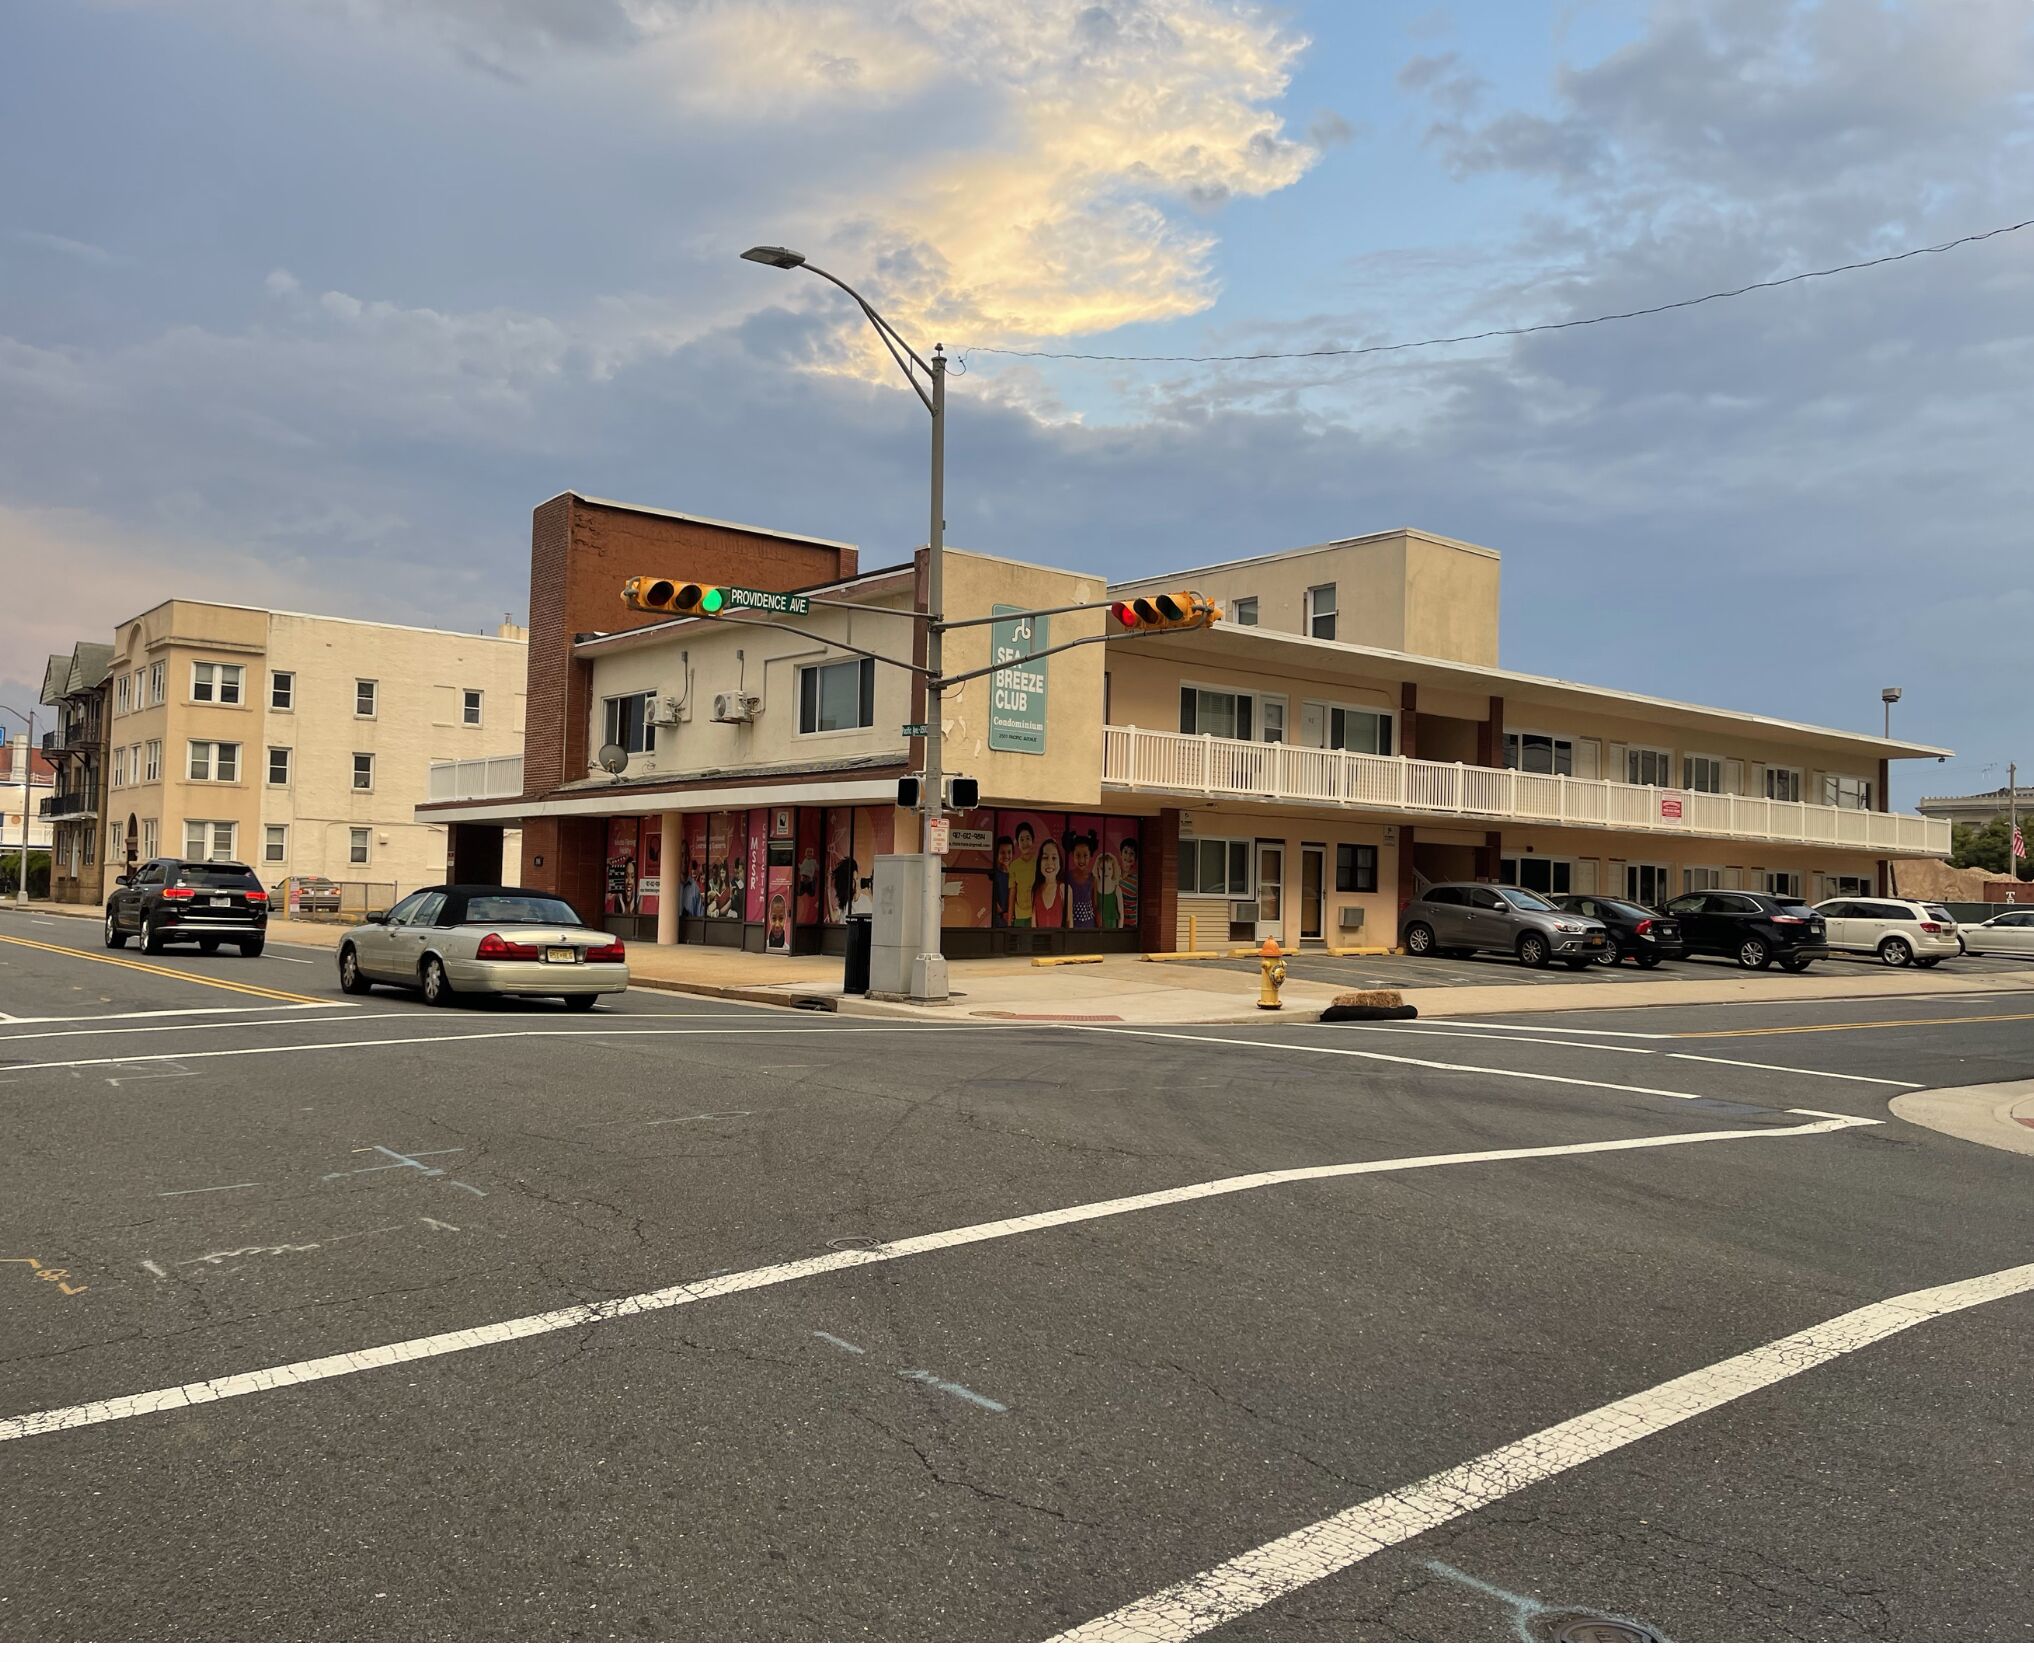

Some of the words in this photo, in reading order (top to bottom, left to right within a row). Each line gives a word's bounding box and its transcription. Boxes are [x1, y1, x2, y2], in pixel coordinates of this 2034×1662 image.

[731, 588, 787, 611] PROVIDENCE
[997, 647, 1022, 669] SEA
[996, 669, 1044, 694] BREEZE
[995, 689, 1028, 712] CLUB
[993, 716, 1043, 731] Condominium
[750, 836, 759, 890] MSSR
